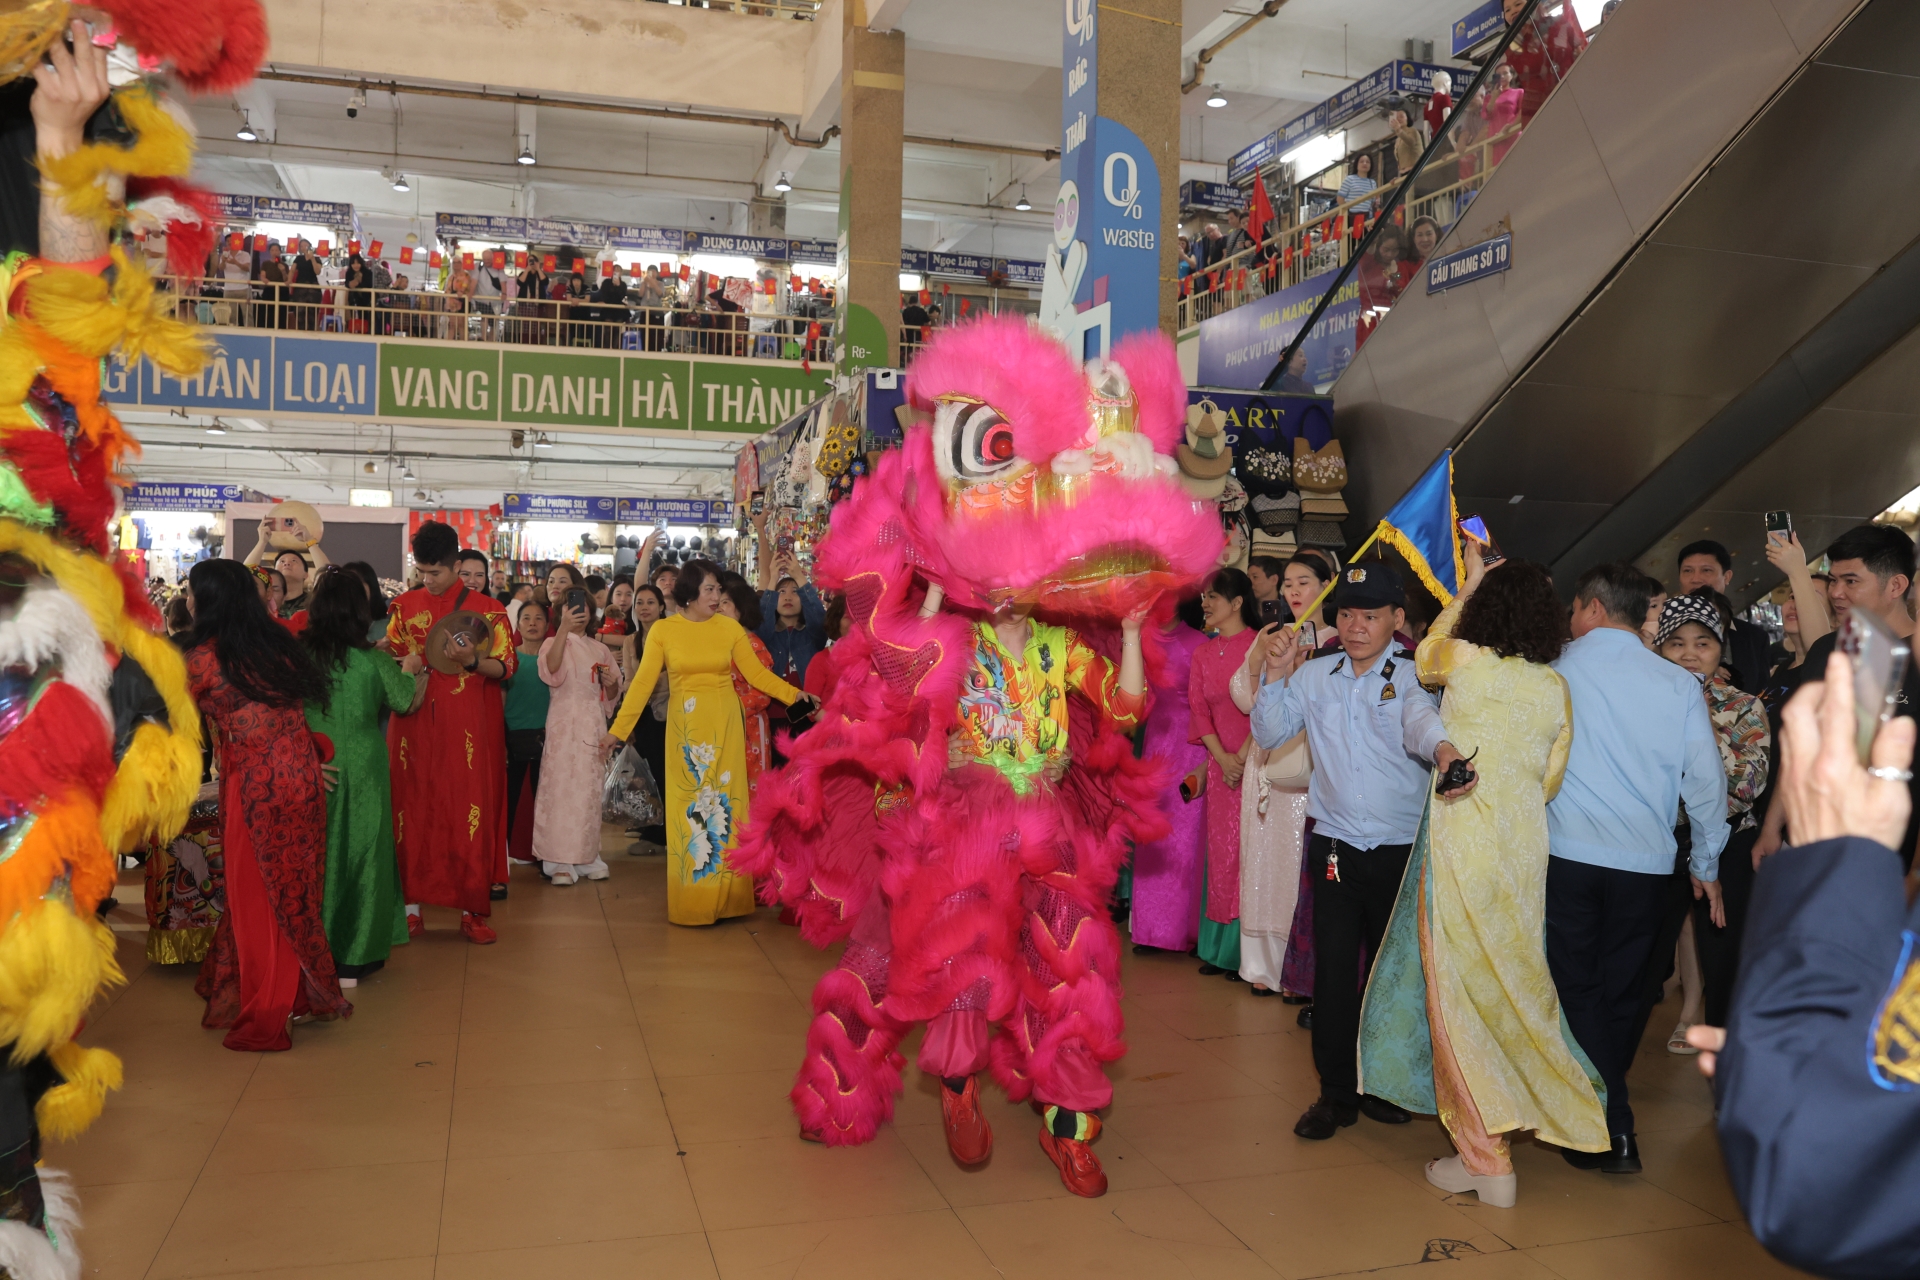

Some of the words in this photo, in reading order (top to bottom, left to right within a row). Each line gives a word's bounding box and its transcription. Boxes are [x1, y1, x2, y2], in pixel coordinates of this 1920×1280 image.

[1068, 56, 1088, 97] RÁC
[1066, 111, 1087, 154] THẢI
[1103, 151, 1142, 220] 0%
[271, 200, 299, 210] LAN
[303, 203, 333, 212] ANH
[702, 236, 734, 249] DUNG
[736, 239, 765, 252] LOAN
[1103, 227, 1155, 250] waste
[902, 250, 917, 263] ờng
[932, 254, 956, 268] Ngọc
[958, 256, 978, 268] Liên
[1450, 254, 1479, 279] THANG
[1480, 242, 1494, 269] SỐ
[1495, 244, 1507, 264] 10
[1007, 264, 1026, 275] TRUNG
[1259, 308, 1280, 331] NHÀ
[1282, 298, 1314, 323] MẠNG
[1225, 348, 1248, 368] PHỤC
[1249, 343, 1262, 360] VỤ
[1313, 320, 1327, 340] UY
[1328, 313, 1346, 335] TÍN
[851, 345, 872, 359] Re-
[284, 360, 367, 411] LOẠI
[390, 366, 489, 411] VANG
[511, 373, 611, 417] DANH
[632, 372, 680, 420] HÀ
[1224, 406, 1285, 429] ART
[138, 484, 180, 497] THÀNH
[184, 485, 218, 498] PHÚC
[574, 499, 588, 509] SILK
[637, 499, 653, 511] HẢI
[656, 501, 690, 511] HƯƠNG
